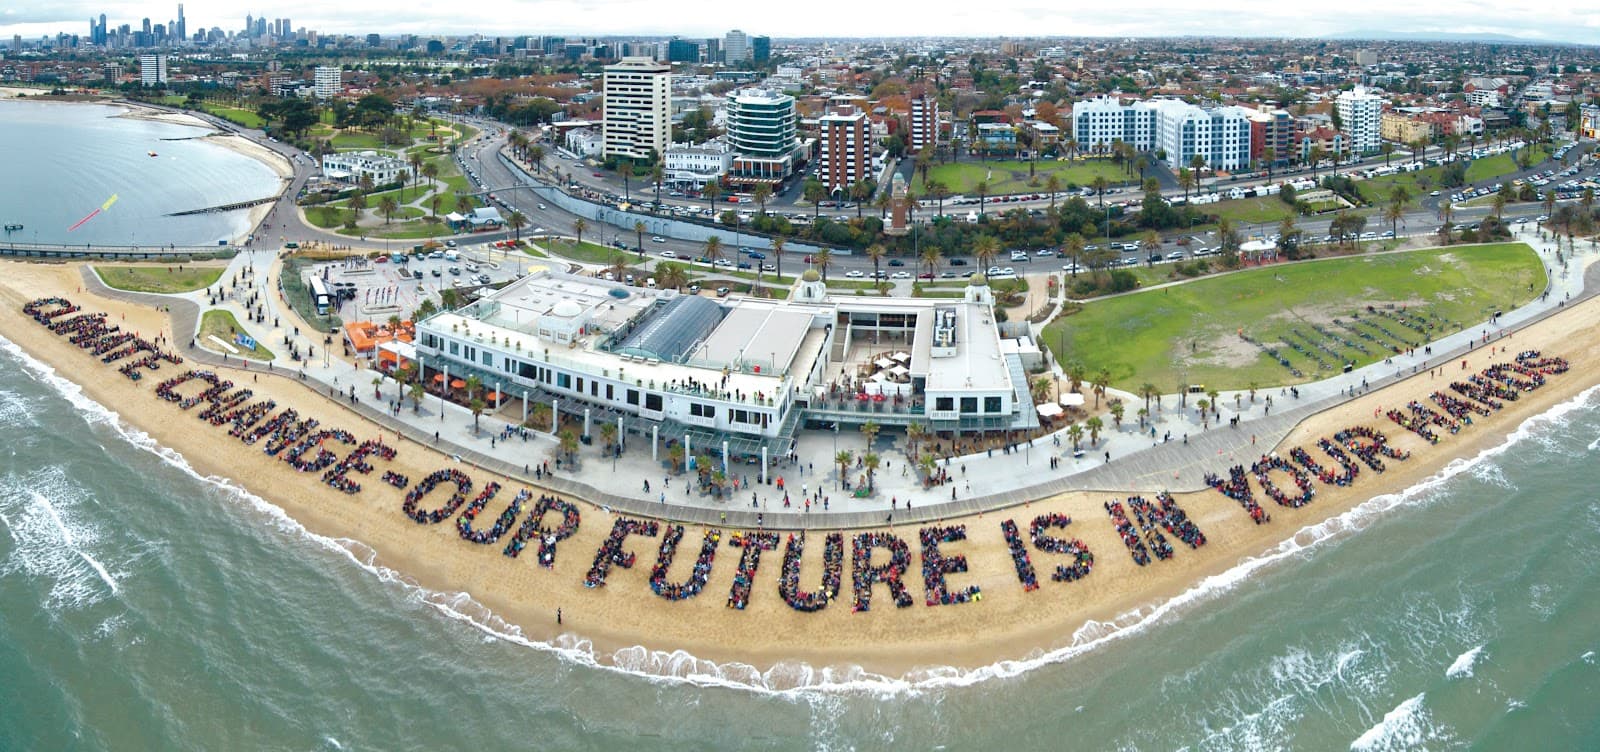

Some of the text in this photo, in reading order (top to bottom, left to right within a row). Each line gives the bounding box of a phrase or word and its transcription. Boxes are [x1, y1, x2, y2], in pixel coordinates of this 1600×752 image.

[23, 296, 184, 381] CLIMATE
[584, 516, 981, 613] FUTURE
[1000, 512, 1094, 592] IS
[1104, 490, 1207, 566] IN
[1204, 426, 1410, 525] YOUR
[1386, 350, 1569, 445] HANDS
